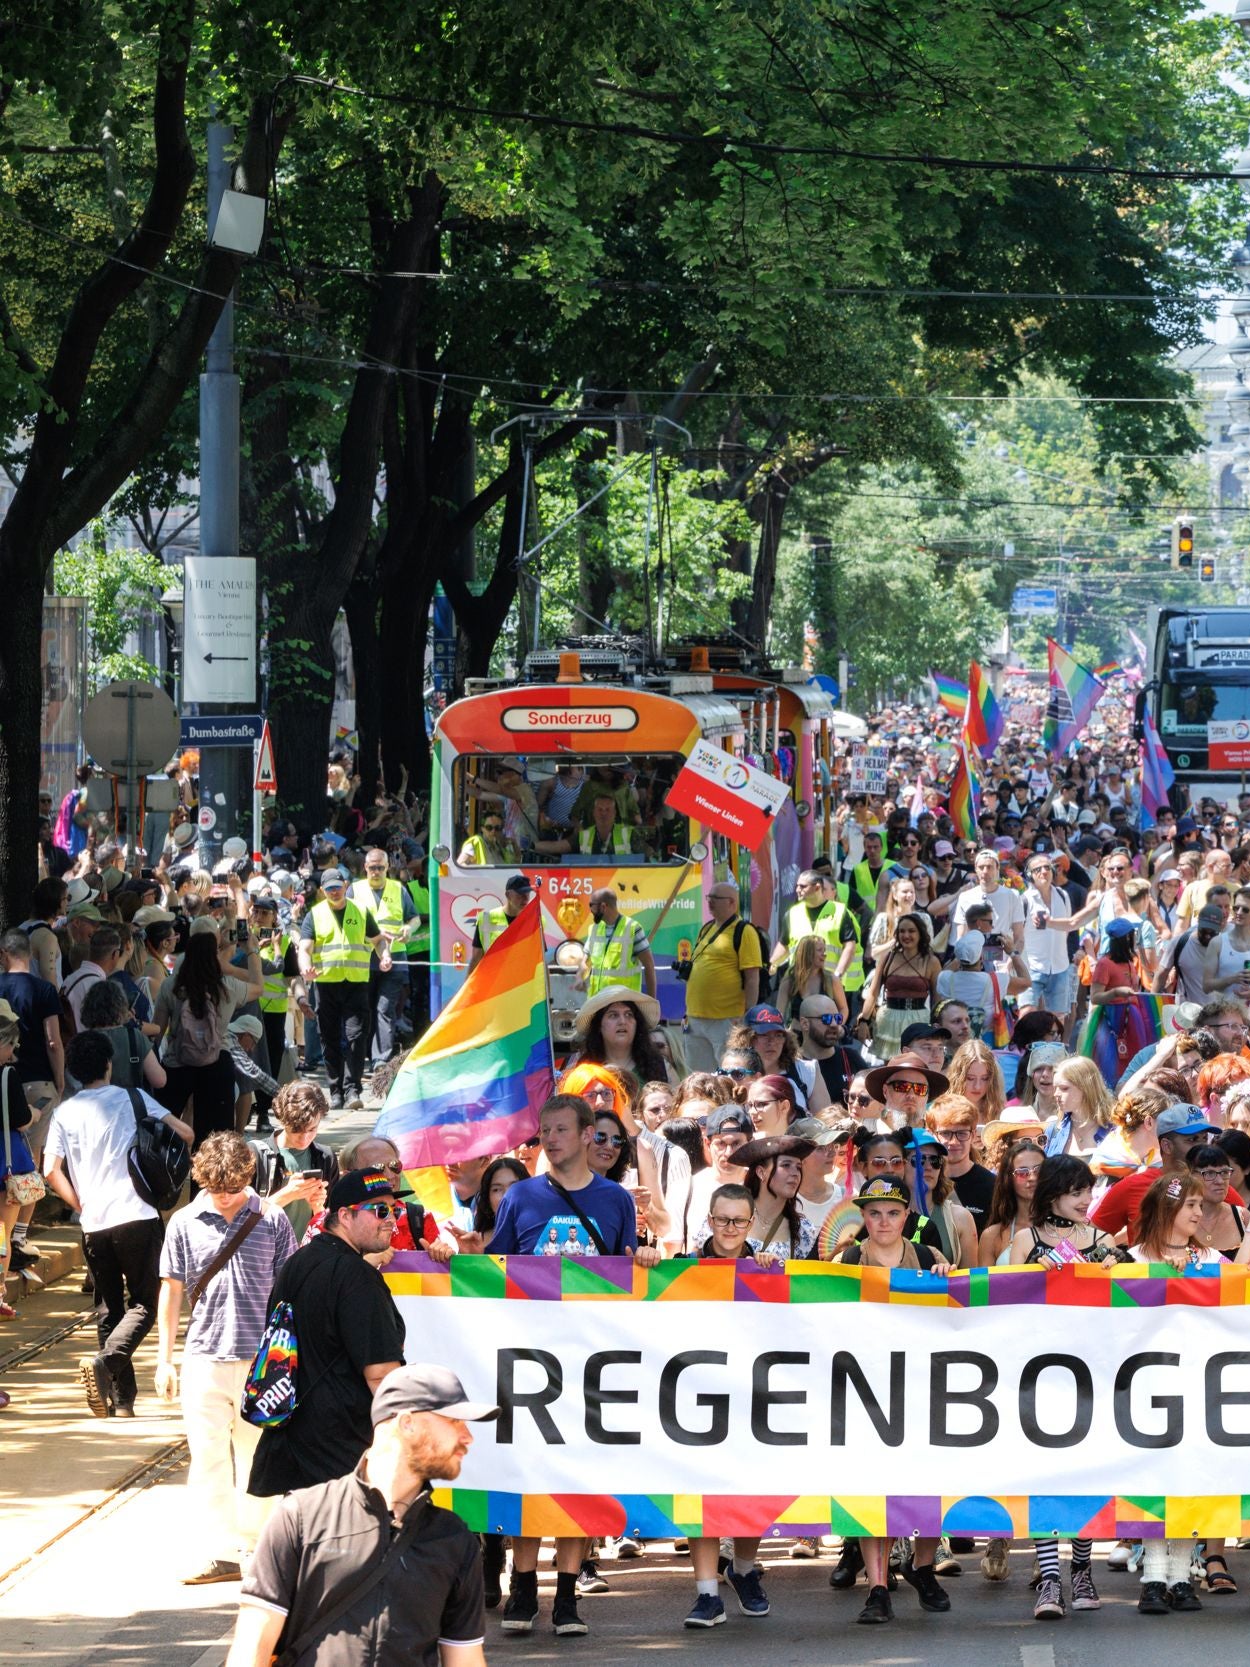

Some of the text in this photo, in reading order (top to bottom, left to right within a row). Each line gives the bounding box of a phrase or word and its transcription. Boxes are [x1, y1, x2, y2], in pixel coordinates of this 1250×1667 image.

[194, 579, 215, 590] THE
[528, 711, 612, 727] Sonderzug
[188, 724, 255, 738] Dumbastraße
[695, 794, 744, 827] Wiener Linien
[548, 877, 594, 895] 6425
